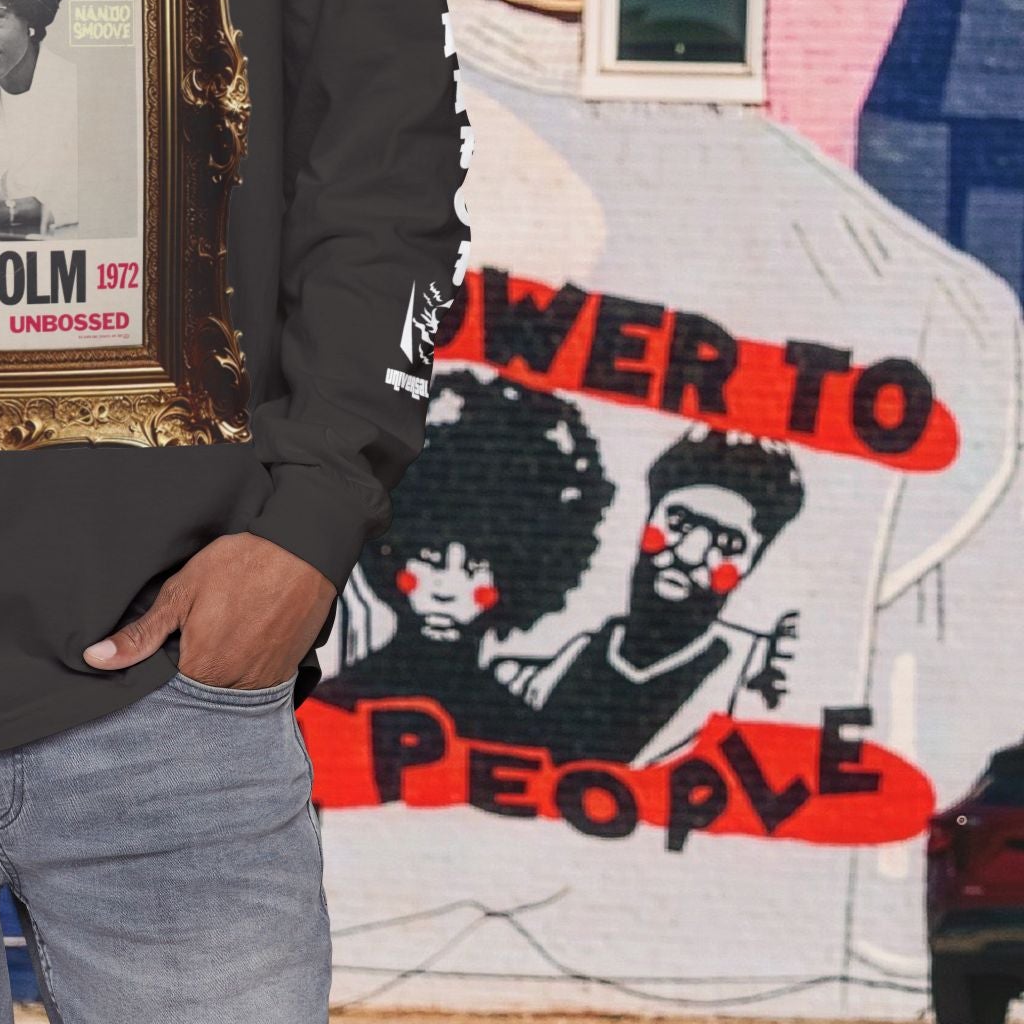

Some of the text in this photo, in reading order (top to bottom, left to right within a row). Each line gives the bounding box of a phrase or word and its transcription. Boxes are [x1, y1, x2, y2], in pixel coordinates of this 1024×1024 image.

[75, 5, 130, 22] NANDO
[73, 22, 130, 39] SMOOVE
[97, 262, 139, 289] 1972
[10, 312, 130, 333] UNBOSSED
[784, 339, 933, 454] TO
[370, 706, 883, 853] PEOPLE
